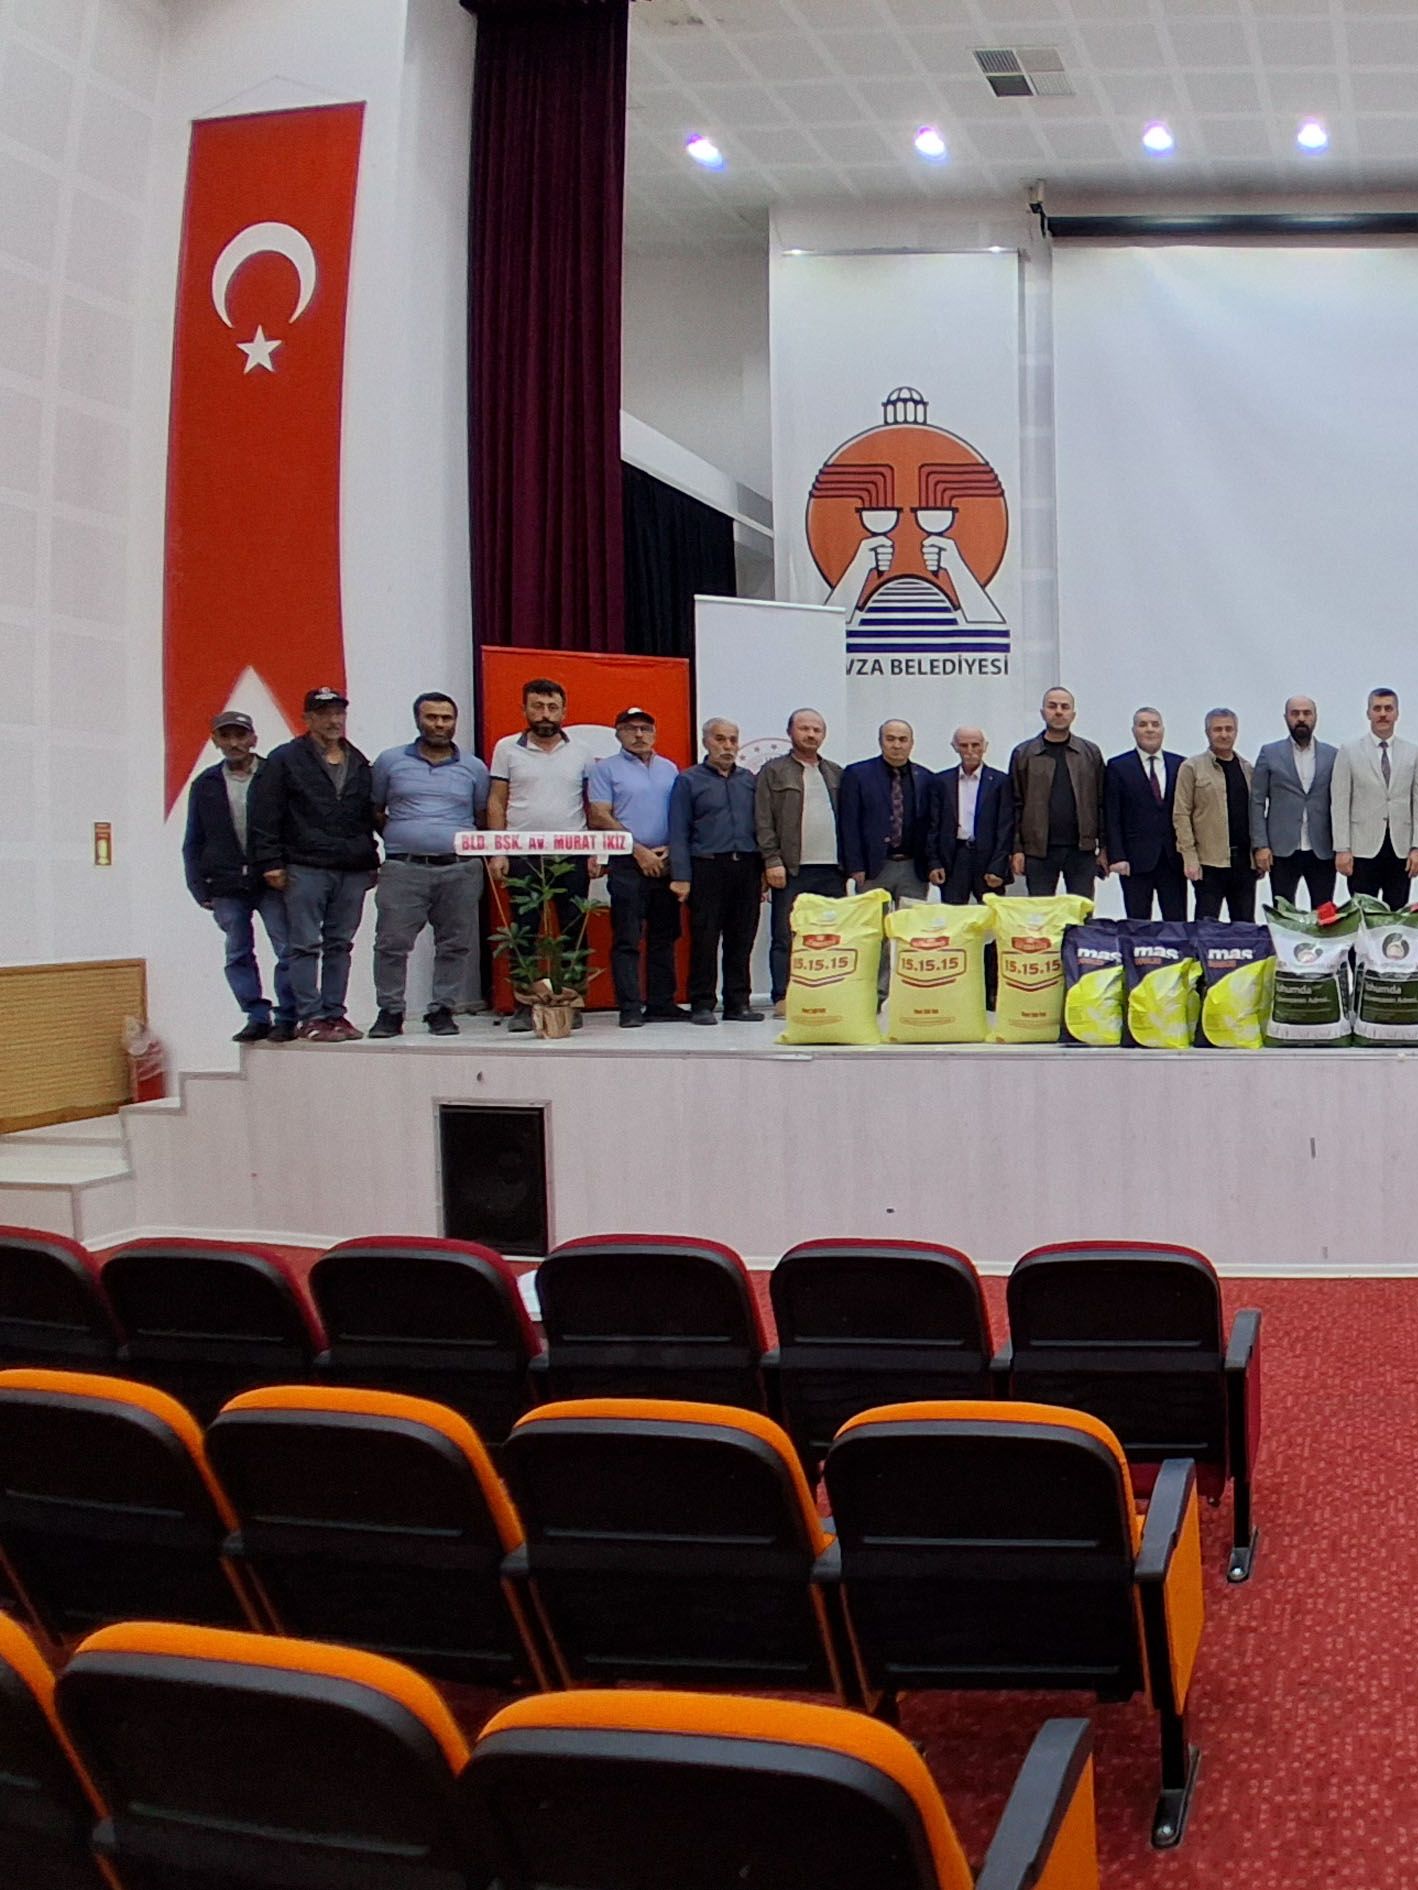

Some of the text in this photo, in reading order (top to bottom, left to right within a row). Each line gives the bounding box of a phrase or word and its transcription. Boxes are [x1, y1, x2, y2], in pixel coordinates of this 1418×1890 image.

[846, 654, 1009, 676] VZA BELEDİYESİ
[553, 834, 597, 850] MURAT
[1077, 947, 1122, 963] mas
[1133, 945, 1179, 960] mas
[1207, 947, 1254, 961] mas
[901, 956, 959, 972] 15.15.15
[1005, 959, 1062, 976] 15.15.15
